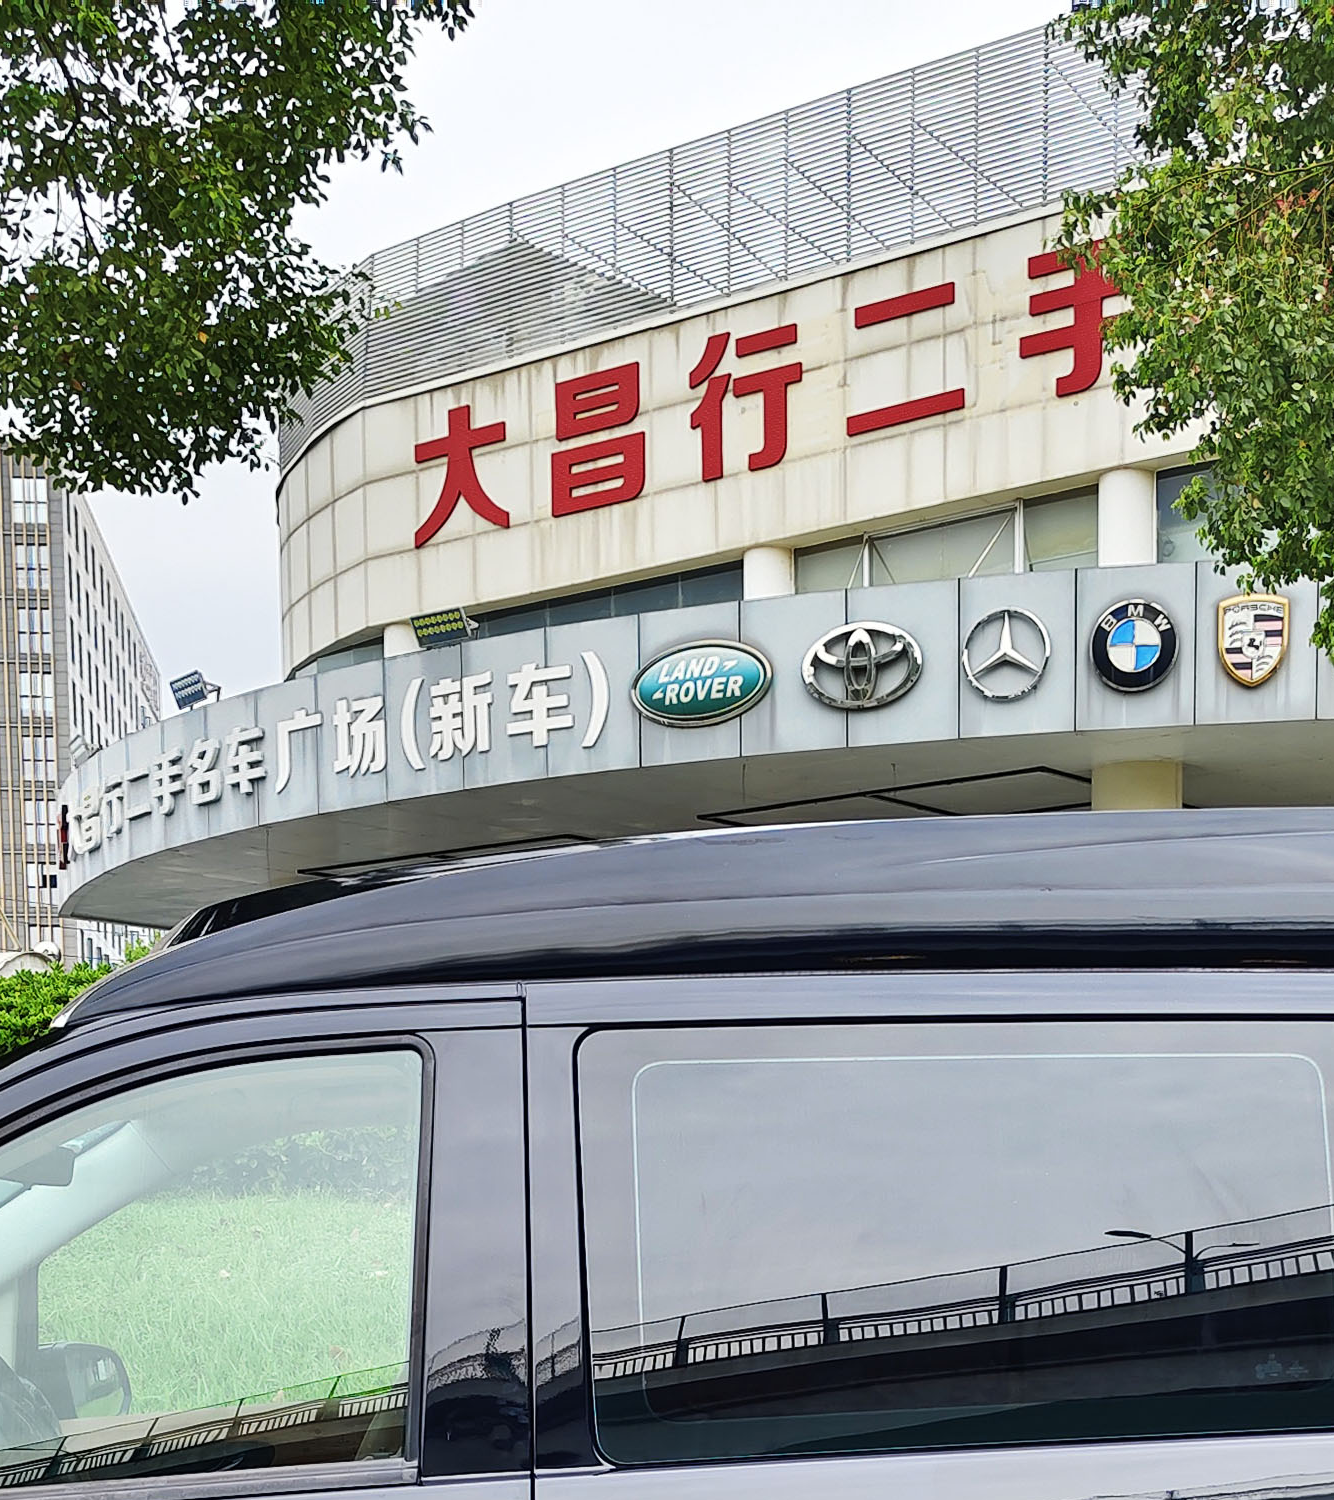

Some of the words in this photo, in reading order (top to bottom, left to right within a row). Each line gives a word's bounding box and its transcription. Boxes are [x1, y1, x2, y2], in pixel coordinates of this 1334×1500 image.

[1101, 604, 1171, 632] BMW
[1224, 603, 1284, 615] PORSCHE
[658, 655, 720, 684] LAND
[664, 674, 744, 706] ROVER
